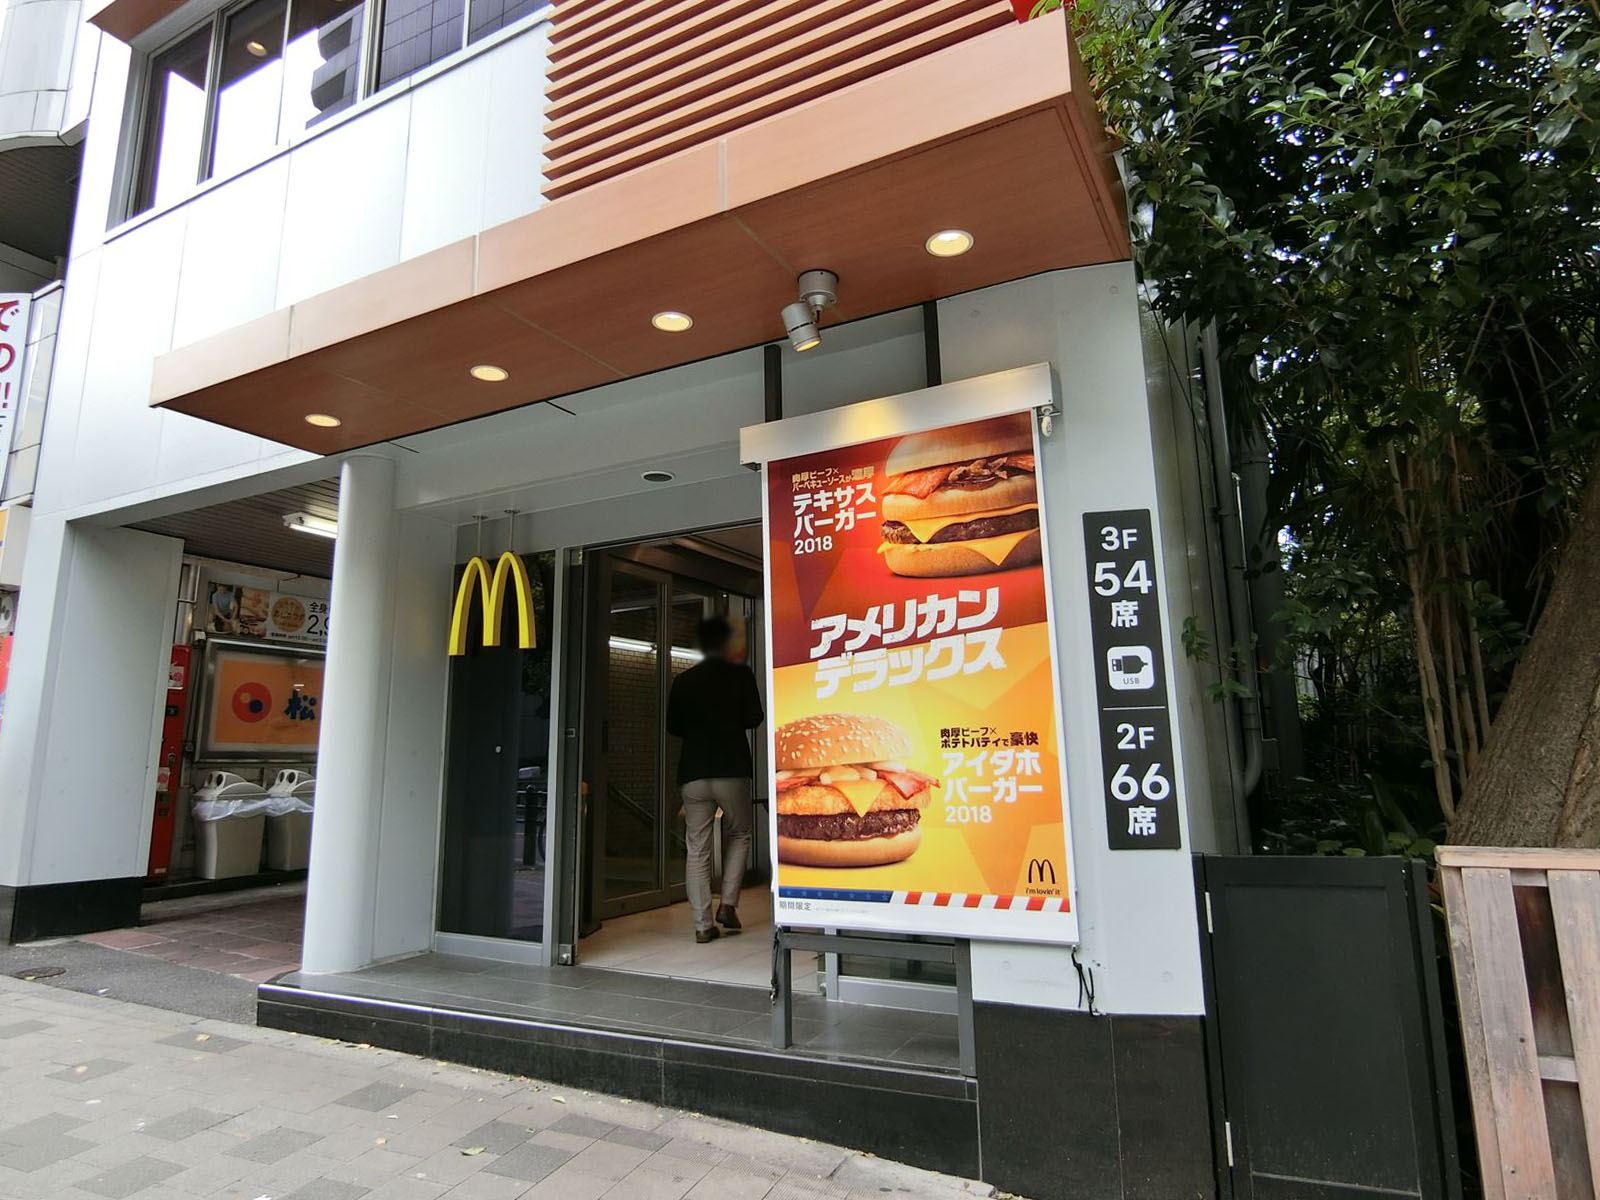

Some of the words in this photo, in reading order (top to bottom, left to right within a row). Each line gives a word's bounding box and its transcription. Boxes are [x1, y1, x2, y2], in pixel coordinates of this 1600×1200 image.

[793, 482, 876, 516] テキサス
[794, 507, 877, 539] バーガー
[794, 535, 833, 555] 2018
[1100, 526, 1138, 551] 3F
[1094, 560, 1152, 597] 54
[810, 586, 1000, 660] アメリカン
[1110, 600, 1139, 628] 席
[815, 627, 1007, 699] デラックス
[1123, 677, 1140, 686] USB
[284, 689, 317, 720] 松
[1116, 723, 1155, 750] 2F
[941, 749, 1042, 777] アイダホ
[943, 776, 1044, 804] バーガー
[1110, 763, 1170, 801] 66
[945, 805, 993, 825] 2018
[1127, 805, 1157, 836] 席
[779, 900, 812, 911] 期間限定
